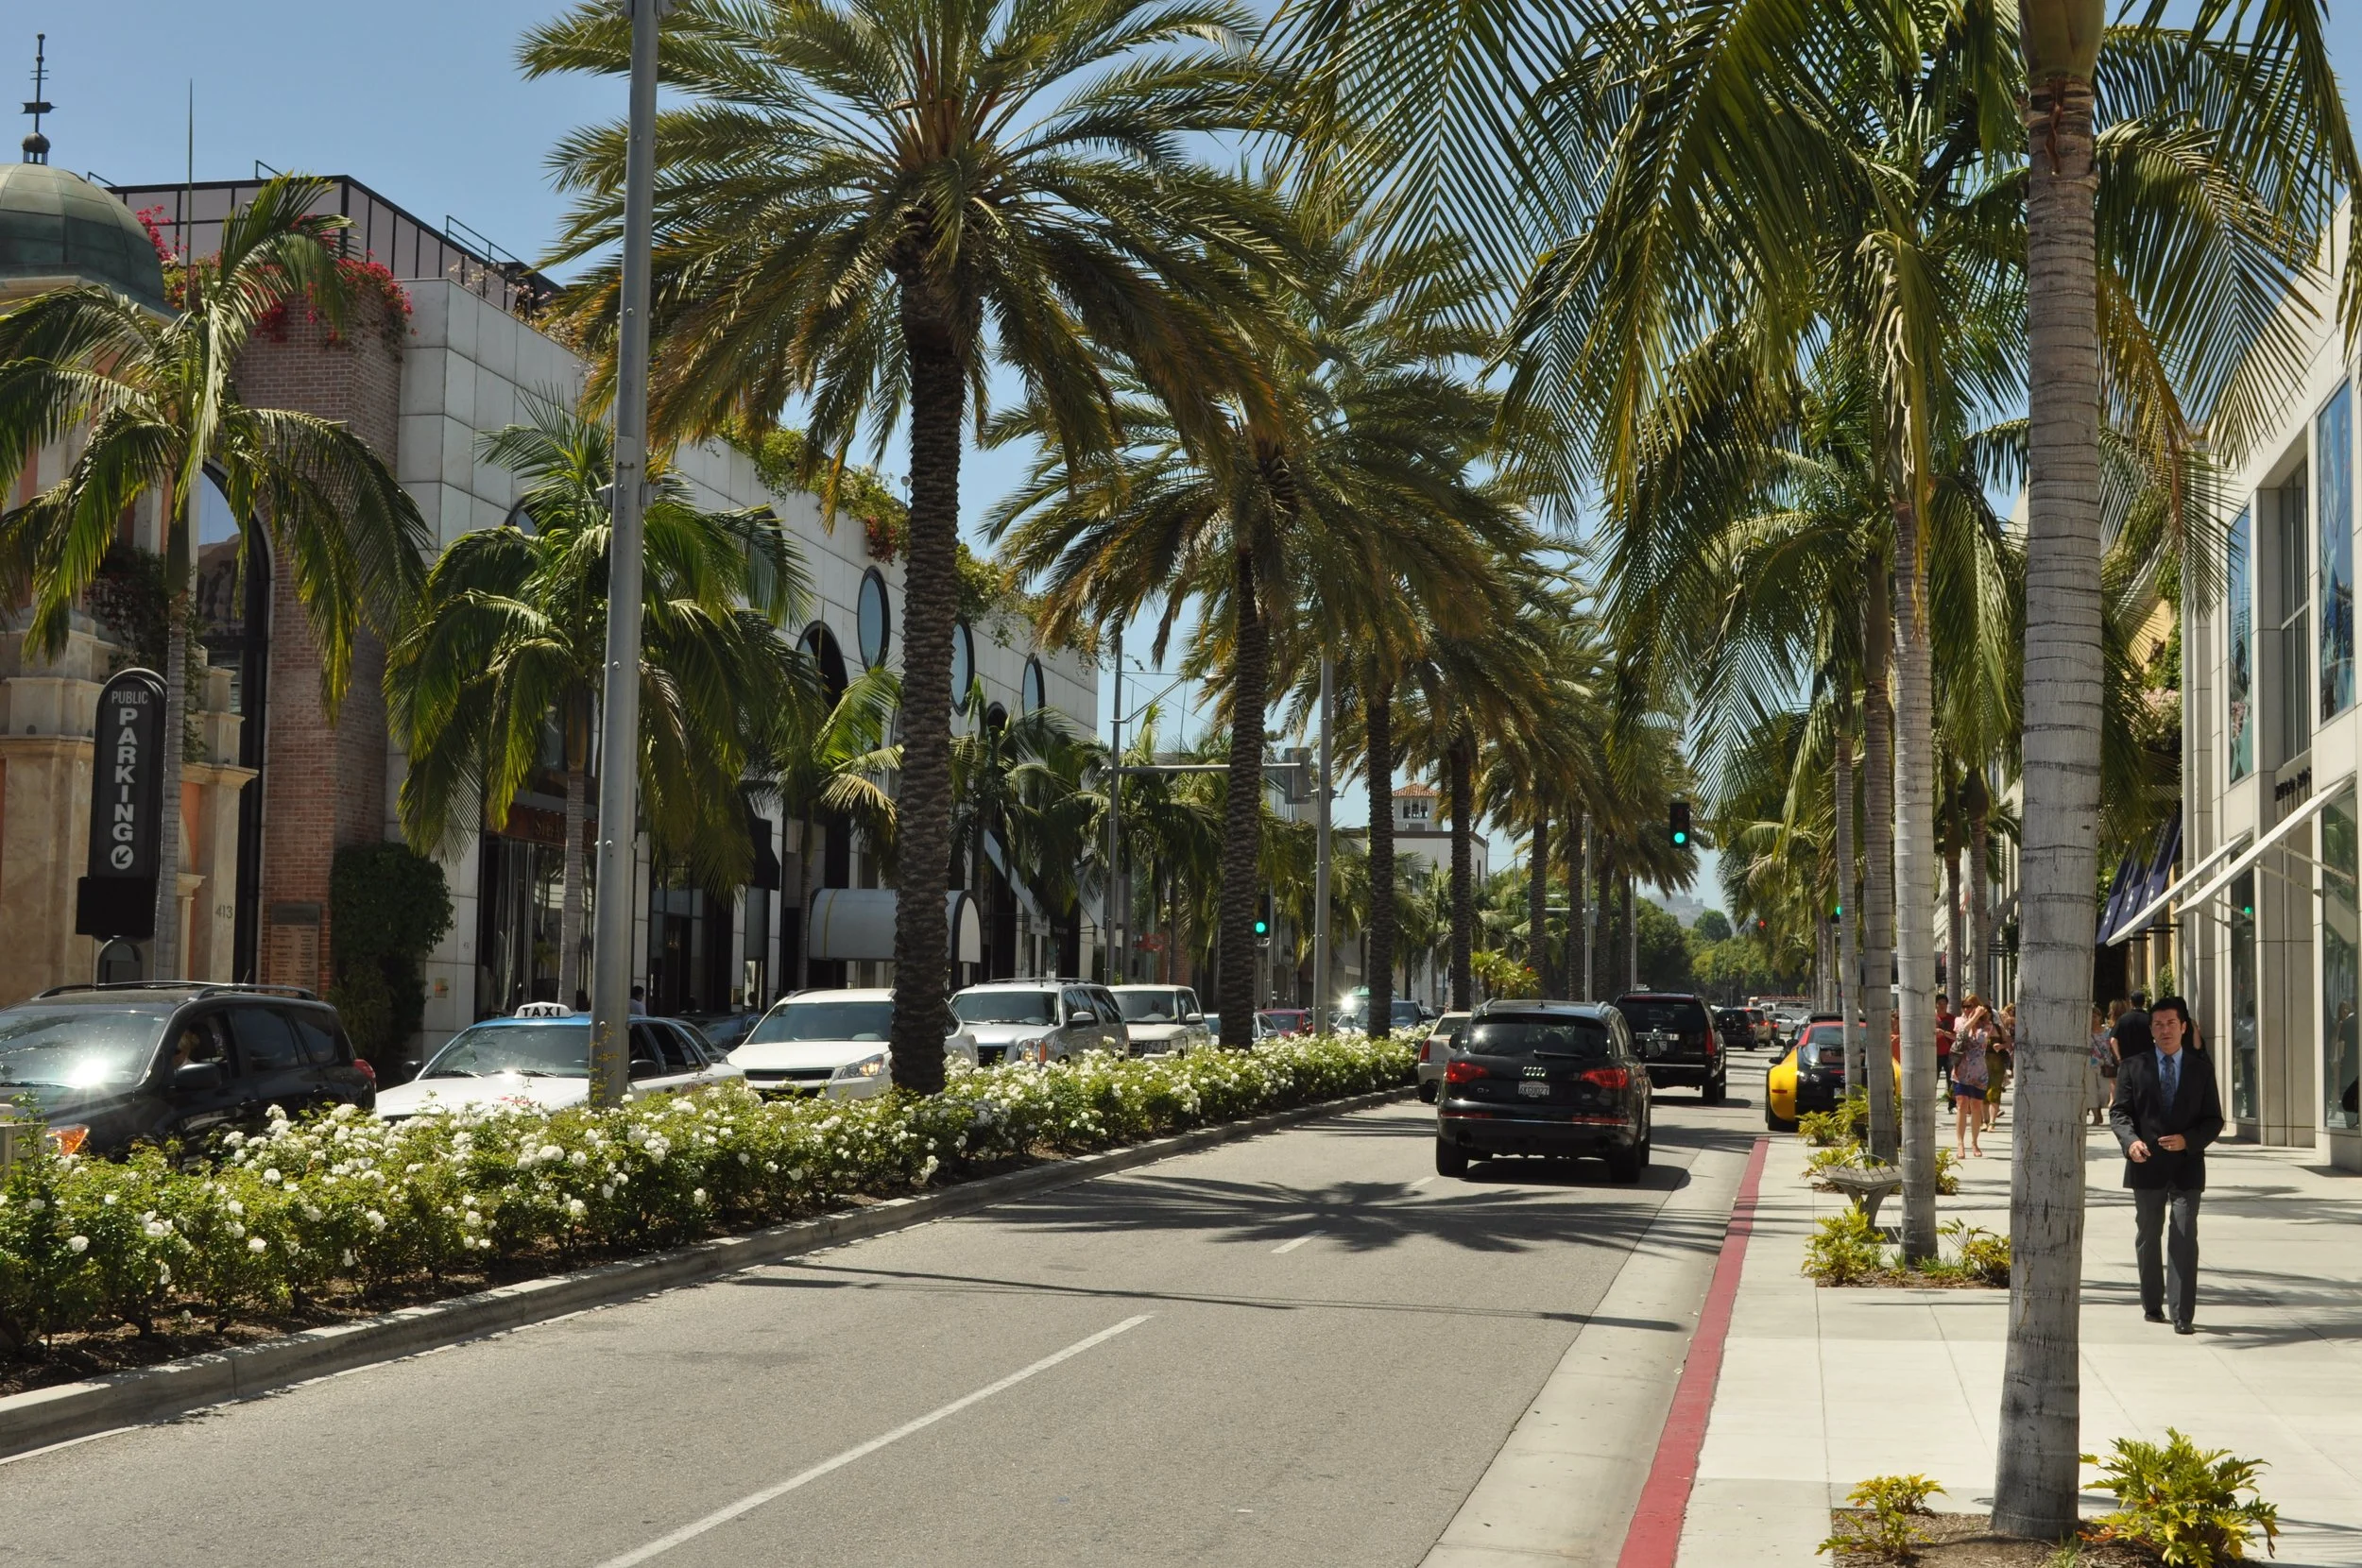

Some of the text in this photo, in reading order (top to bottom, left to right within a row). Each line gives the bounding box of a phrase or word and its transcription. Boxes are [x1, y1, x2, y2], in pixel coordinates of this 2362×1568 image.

[111, 690, 148, 705] PUBLIC
[111, 707, 139, 843] PARKING
[215, 905, 233, 919] 413
[522, 1007, 561, 1017] TAXI
